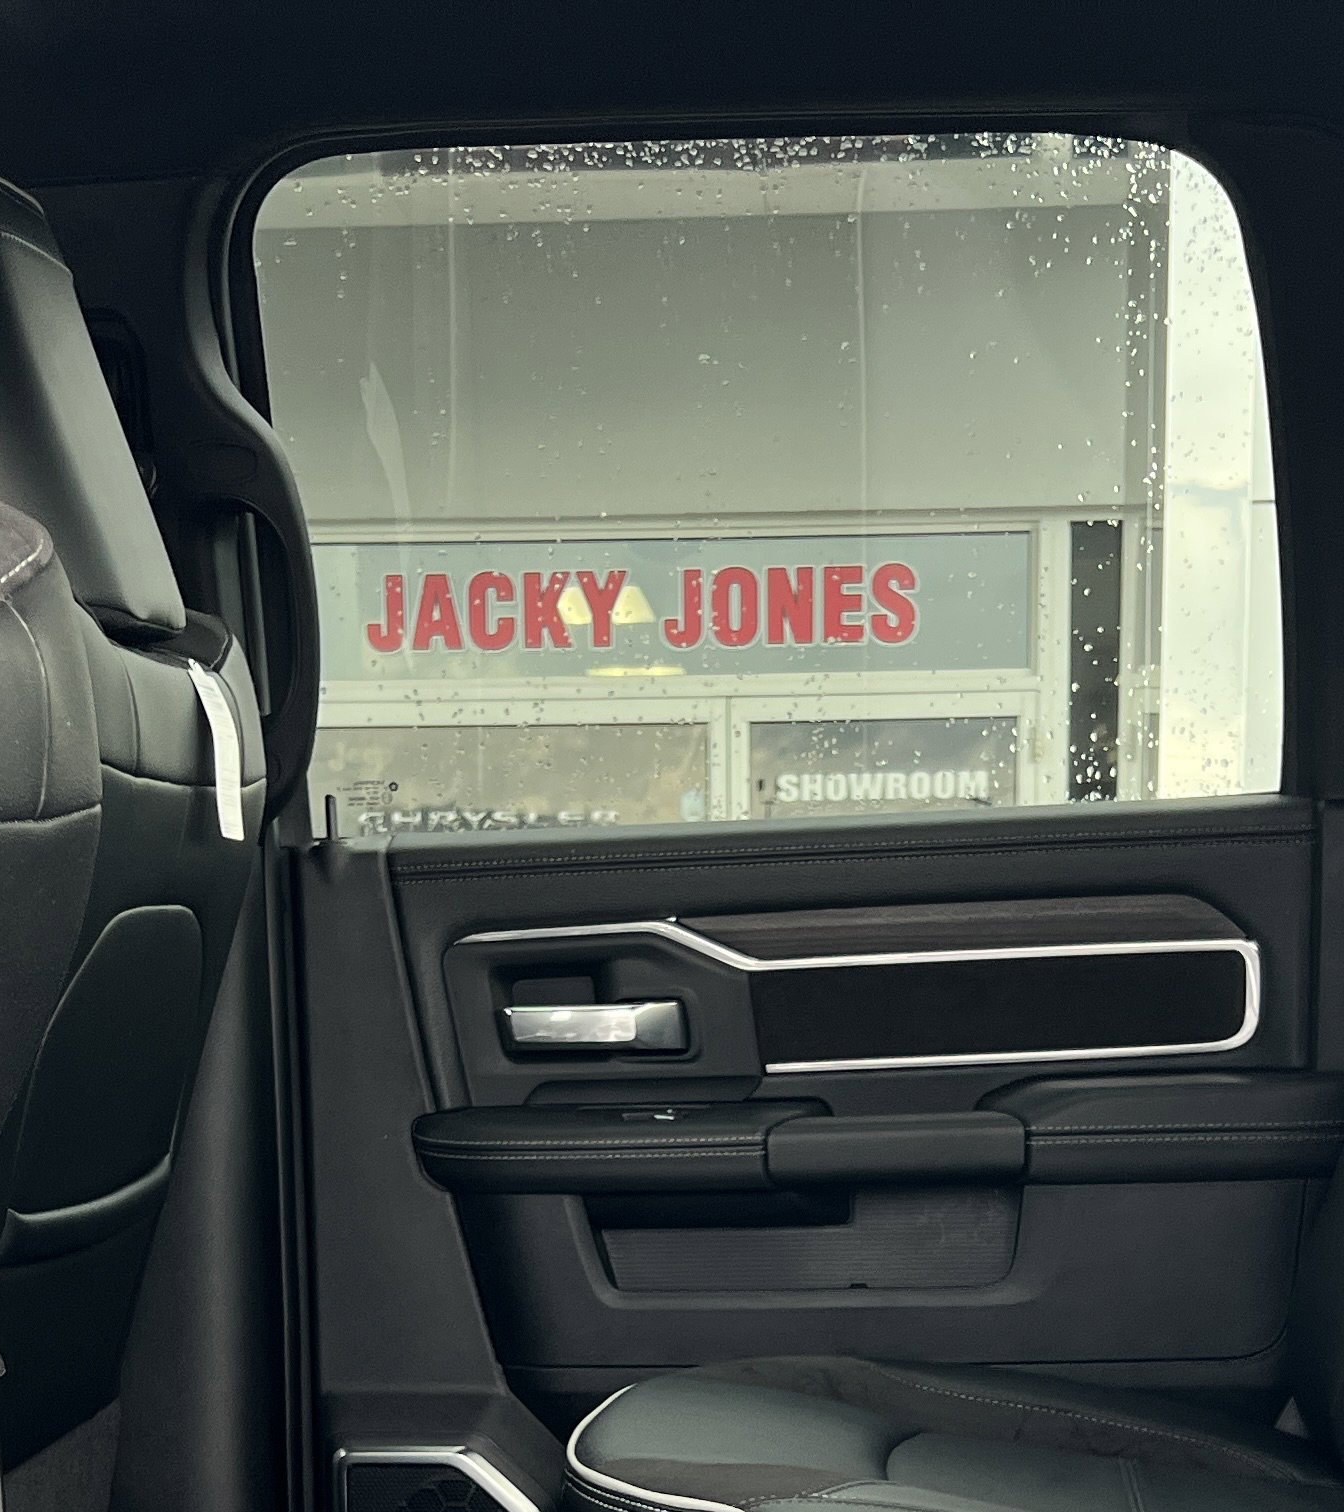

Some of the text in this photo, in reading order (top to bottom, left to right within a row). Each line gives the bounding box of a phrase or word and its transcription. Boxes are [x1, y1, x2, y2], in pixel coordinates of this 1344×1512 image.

[365, 562, 917, 653] JACKY JONES
[777, 769, 990, 802] SHOWROOM
